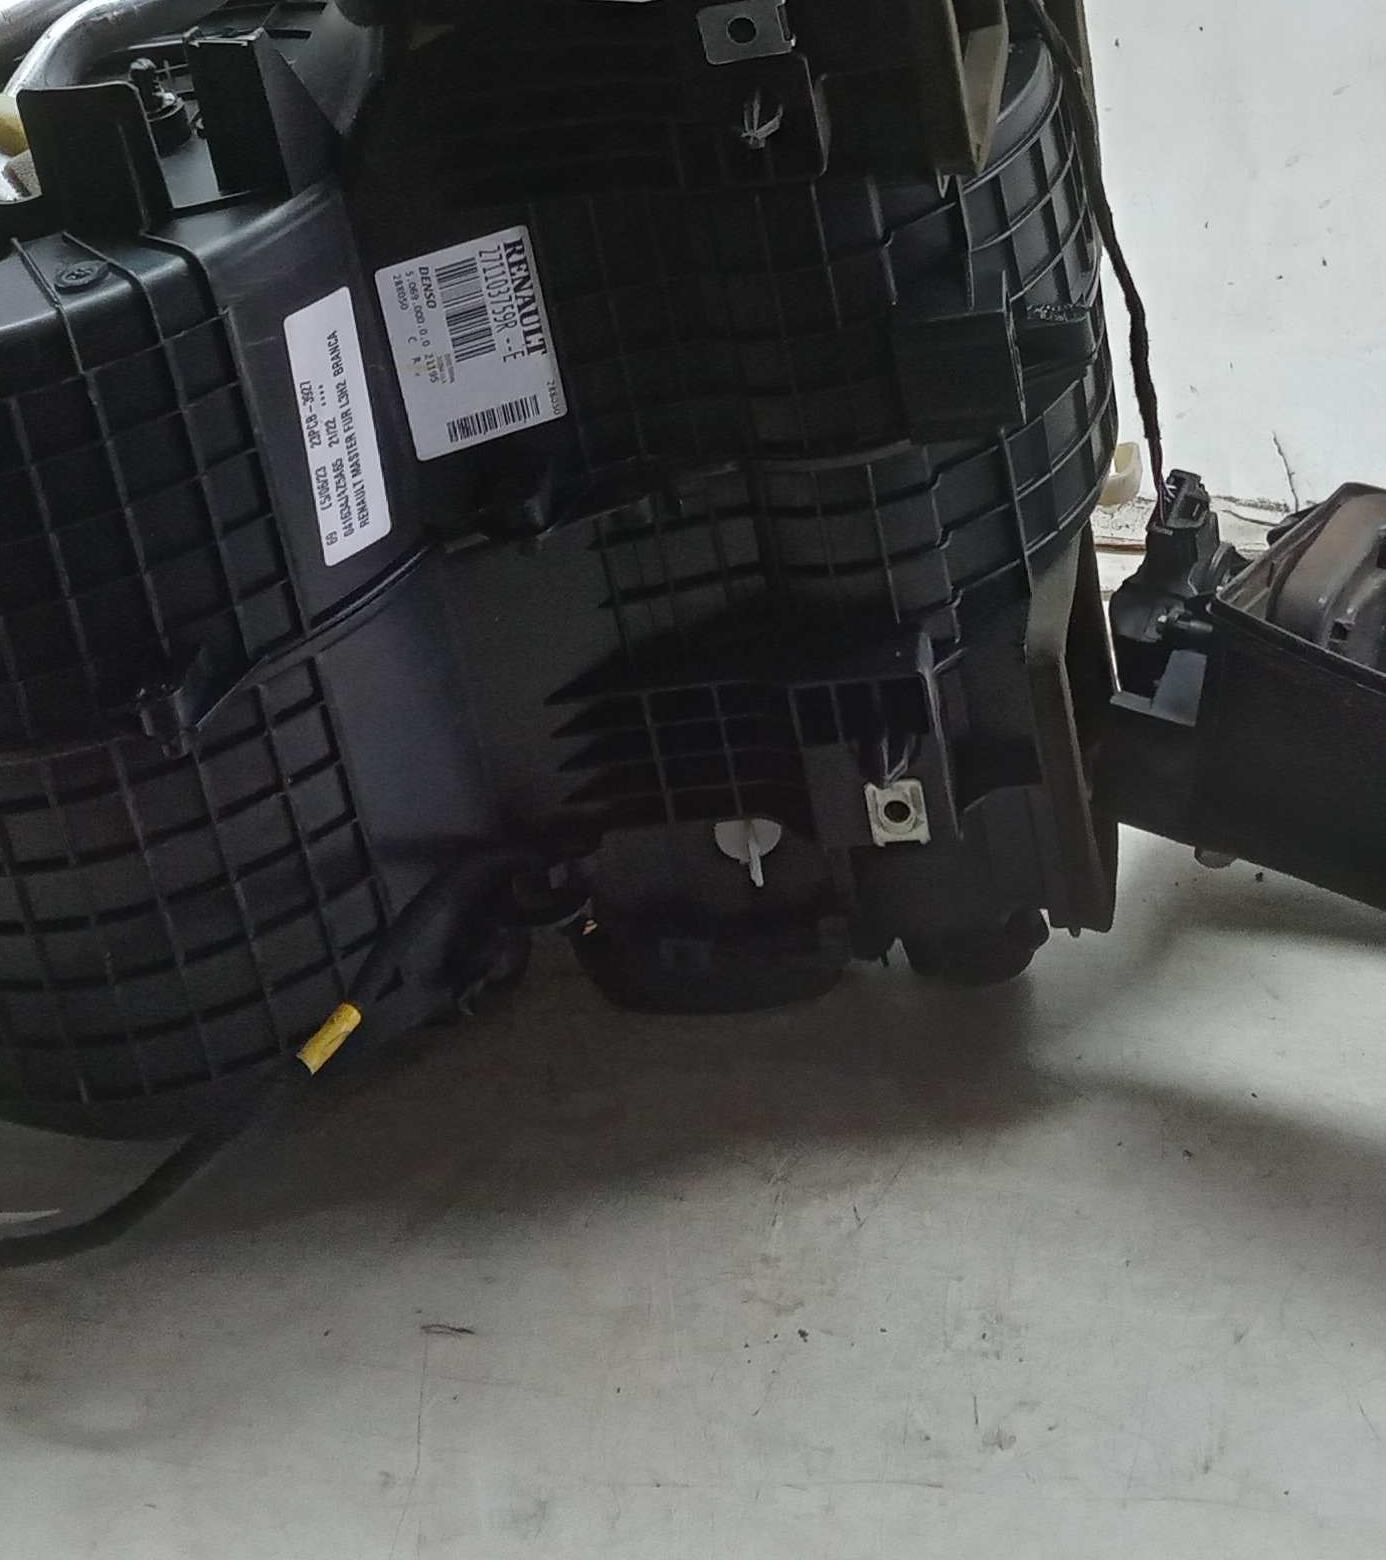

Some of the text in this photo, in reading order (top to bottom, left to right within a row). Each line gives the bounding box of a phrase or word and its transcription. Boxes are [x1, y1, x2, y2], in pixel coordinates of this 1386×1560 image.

[393, 274, 409, 310] 288050
[405, 271, 430, 347] 5.069.000.0.0
[418, 266, 437, 309] DENSO
[478, 245, 517, 333] 271103759R
[503, 235, 548, 356] RENAULT
[324, 416, 340, 448] 21/22
[327, 330, 370, 528] RENAULT MASTER FUR L3H2 BRANCA
[325, 531, 338, 546] 69
